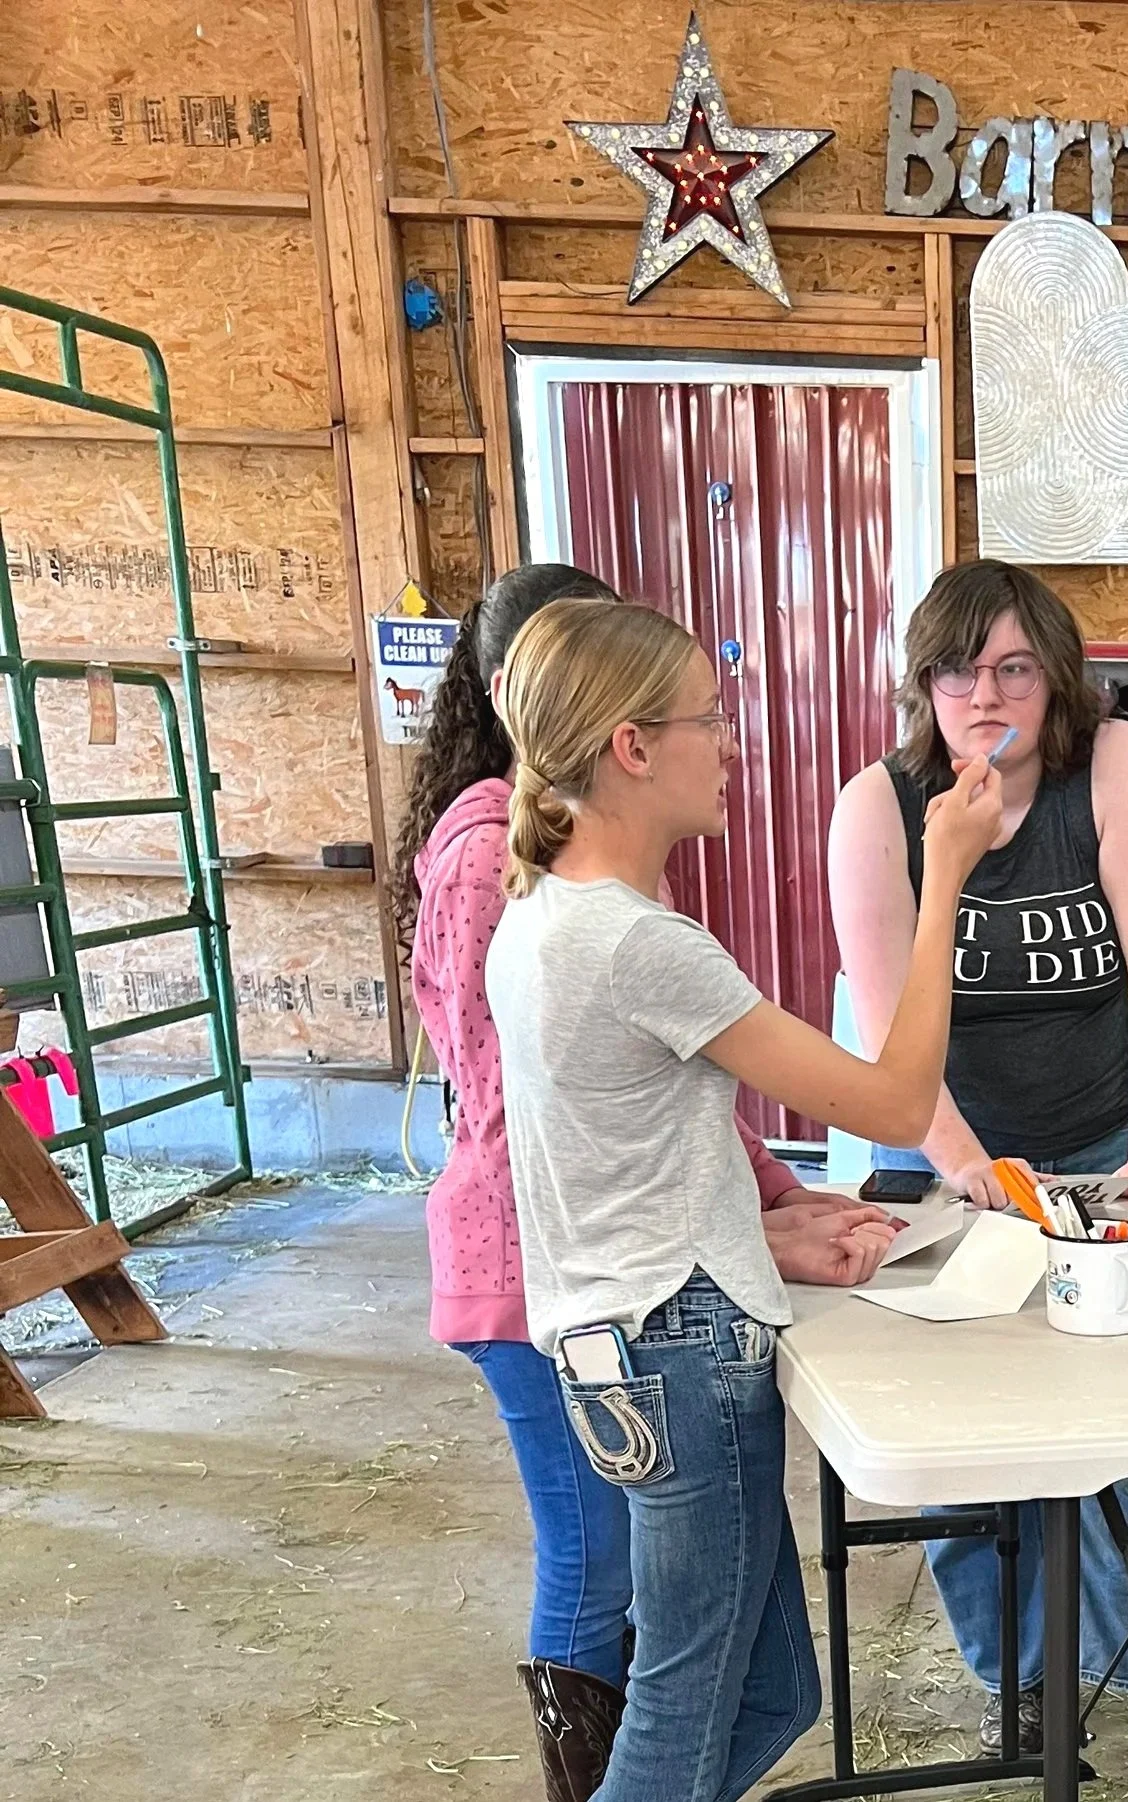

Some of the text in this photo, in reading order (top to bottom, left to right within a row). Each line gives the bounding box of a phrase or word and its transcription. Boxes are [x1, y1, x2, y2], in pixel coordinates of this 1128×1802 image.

[393, 626, 444, 645] PLEASE
[383, 644, 428, 663] CLEAN
[1018, 899, 1107, 944] DID
[1026, 940, 1121, 984] DIE
